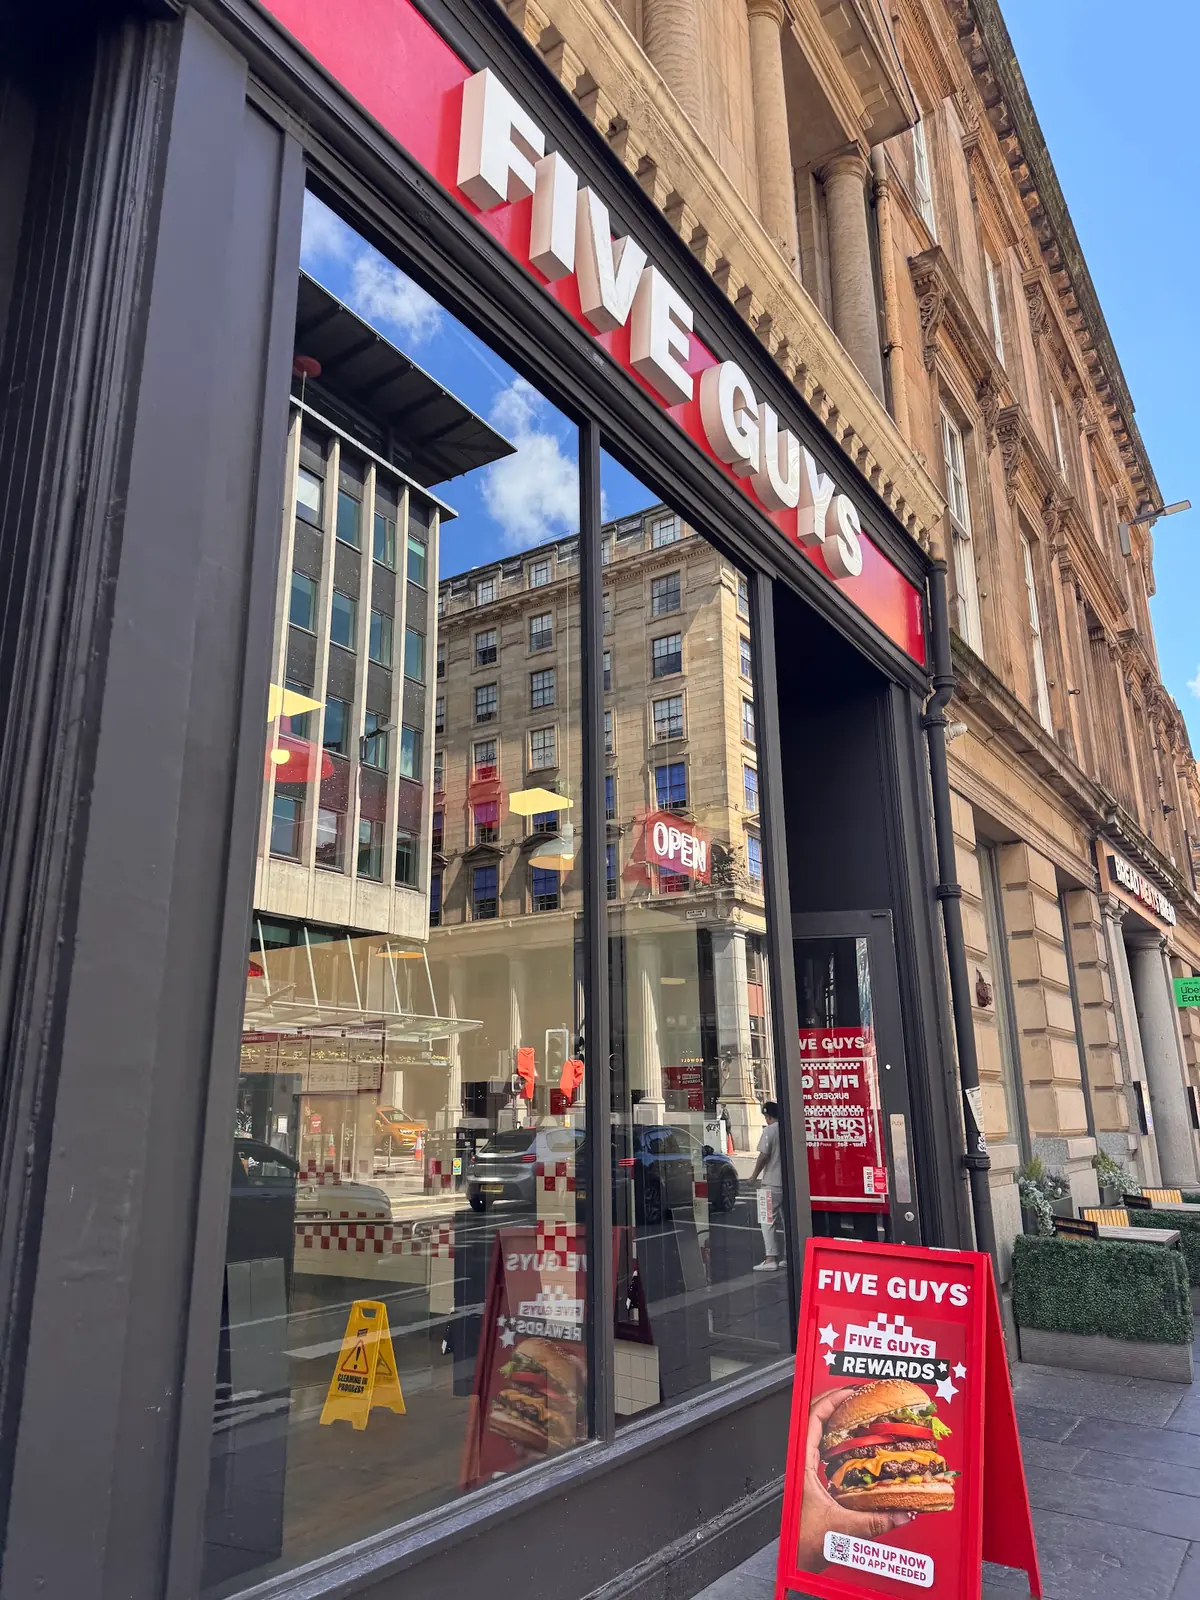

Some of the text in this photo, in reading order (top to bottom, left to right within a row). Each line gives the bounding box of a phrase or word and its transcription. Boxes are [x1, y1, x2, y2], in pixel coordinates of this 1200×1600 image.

[458, 67, 863, 579] FIVE GUYS
[653, 821, 707, 872] OPEN
[799, 1037, 865, 1050] VE GUYS
[818, 1269, 969, 1307] FIVE GUYS
[849, 1333, 930, 1357] FIVE GUYS
[338, 1374, 361, 1384] CLEANING
[842, 1356, 935, 1380] REWARDS
[338, 1383, 364, 1393] PROGRESS
[851, 1554, 926, 1581] NO APP NEEDED
[852, 1542, 927, 1570] SIGN UP NOW
